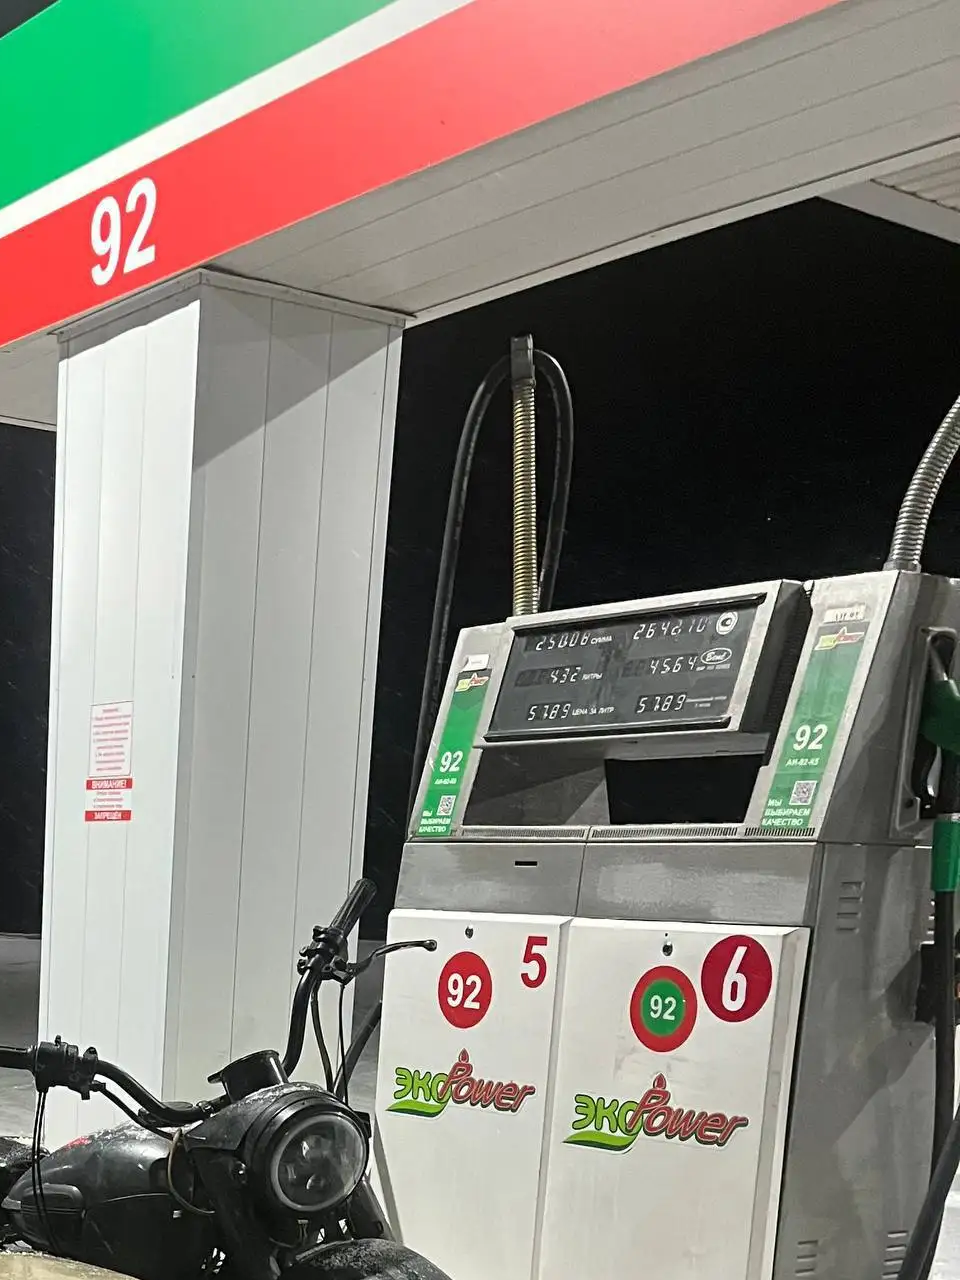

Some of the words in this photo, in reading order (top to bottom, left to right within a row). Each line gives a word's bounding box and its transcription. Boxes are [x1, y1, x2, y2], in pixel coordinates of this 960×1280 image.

[91, 177, 157, 286] 92
[793, 724, 828, 750] 92
[440, 751, 463, 772] 92
[762, 818, 803, 826] КАЧЕСТВО
[521, 936, 547, 988] 5
[447, 972, 482, 1009] 92
[722, 946, 747, 1012] 6
[650, 995, 676, 1020] 92
